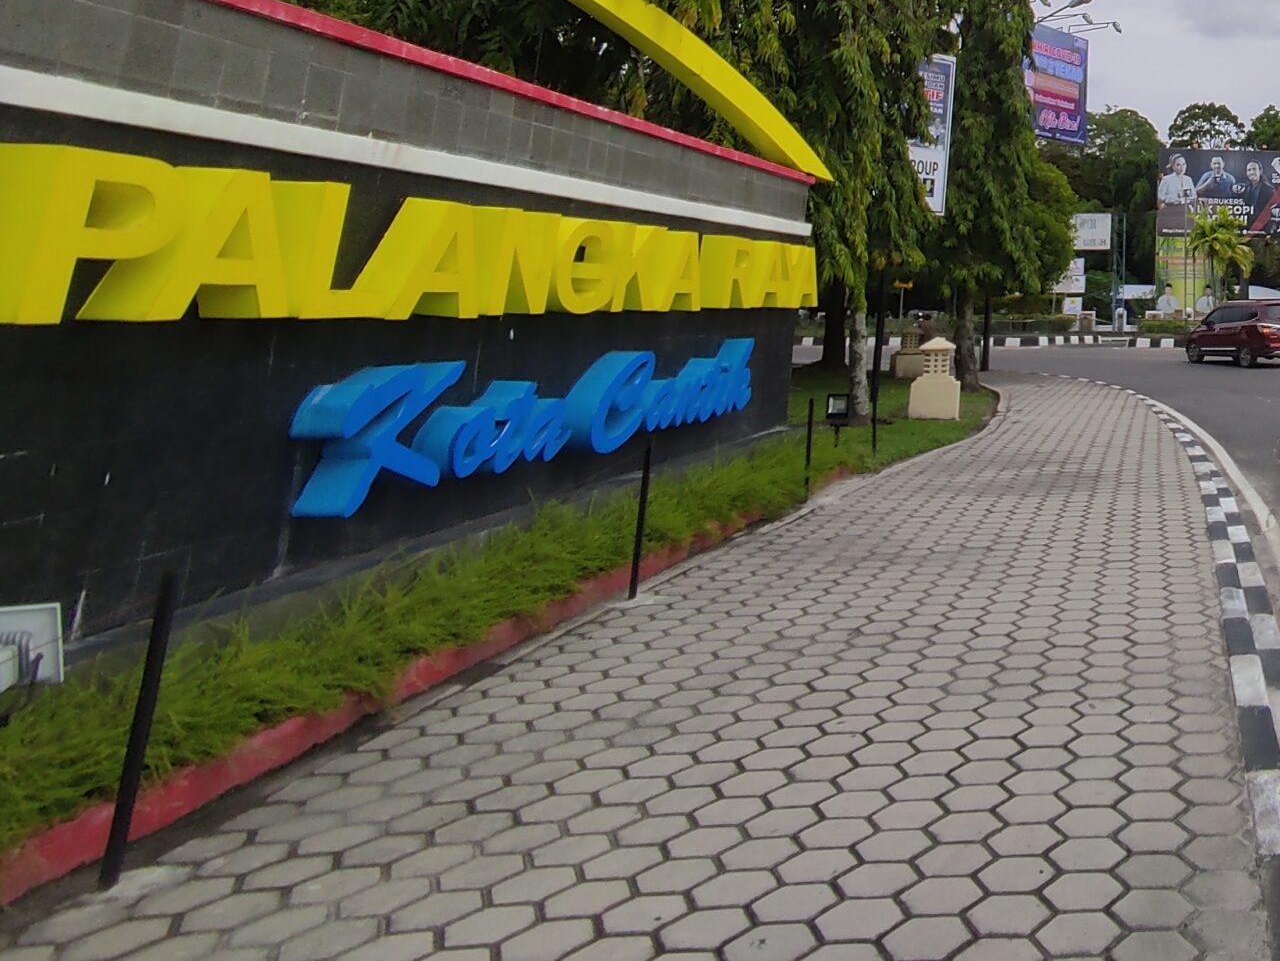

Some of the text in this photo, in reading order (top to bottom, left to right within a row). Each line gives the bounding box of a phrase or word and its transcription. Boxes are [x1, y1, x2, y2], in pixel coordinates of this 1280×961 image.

[0, 143, 817, 325] PALANGKA RAYA
[289, 338, 756, 519] Kota Cantik
